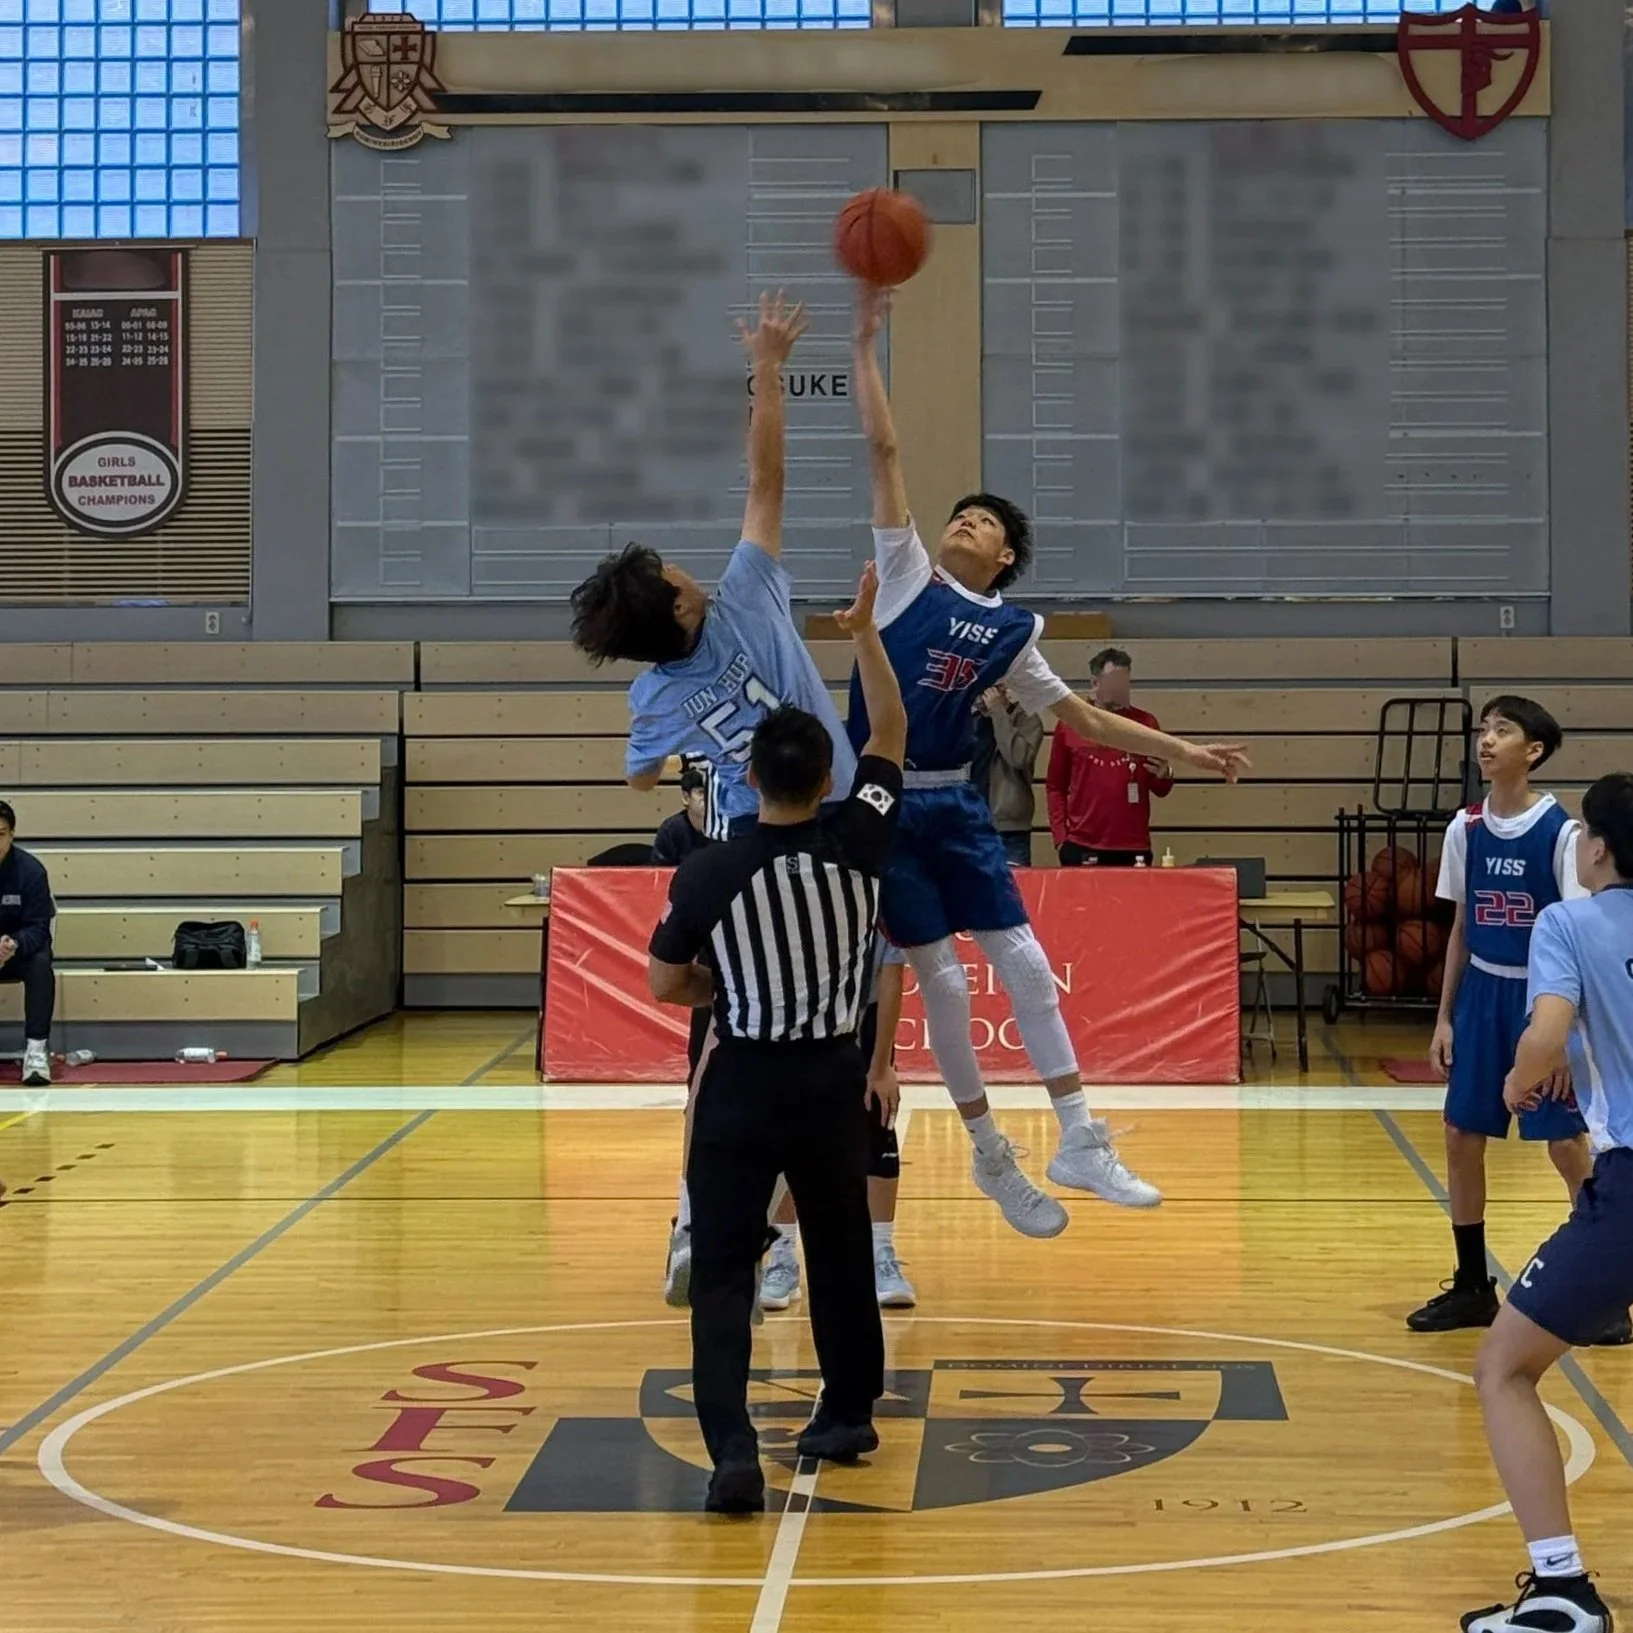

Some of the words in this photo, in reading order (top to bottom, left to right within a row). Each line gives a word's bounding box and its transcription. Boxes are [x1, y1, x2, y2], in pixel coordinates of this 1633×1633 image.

[97, 457, 136, 468] GIRLS
[68, 474, 165, 488] BASKETBALL
[77, 494, 155, 506] CHAMPIONS
[682, 687, 718, 719] JUN
[1485, 857, 1526, 876] YISS
[1474, 889, 1537, 927] 22
[314, 1361, 538, 1509] SFS
[1154, 1498, 1308, 1513] 1912
